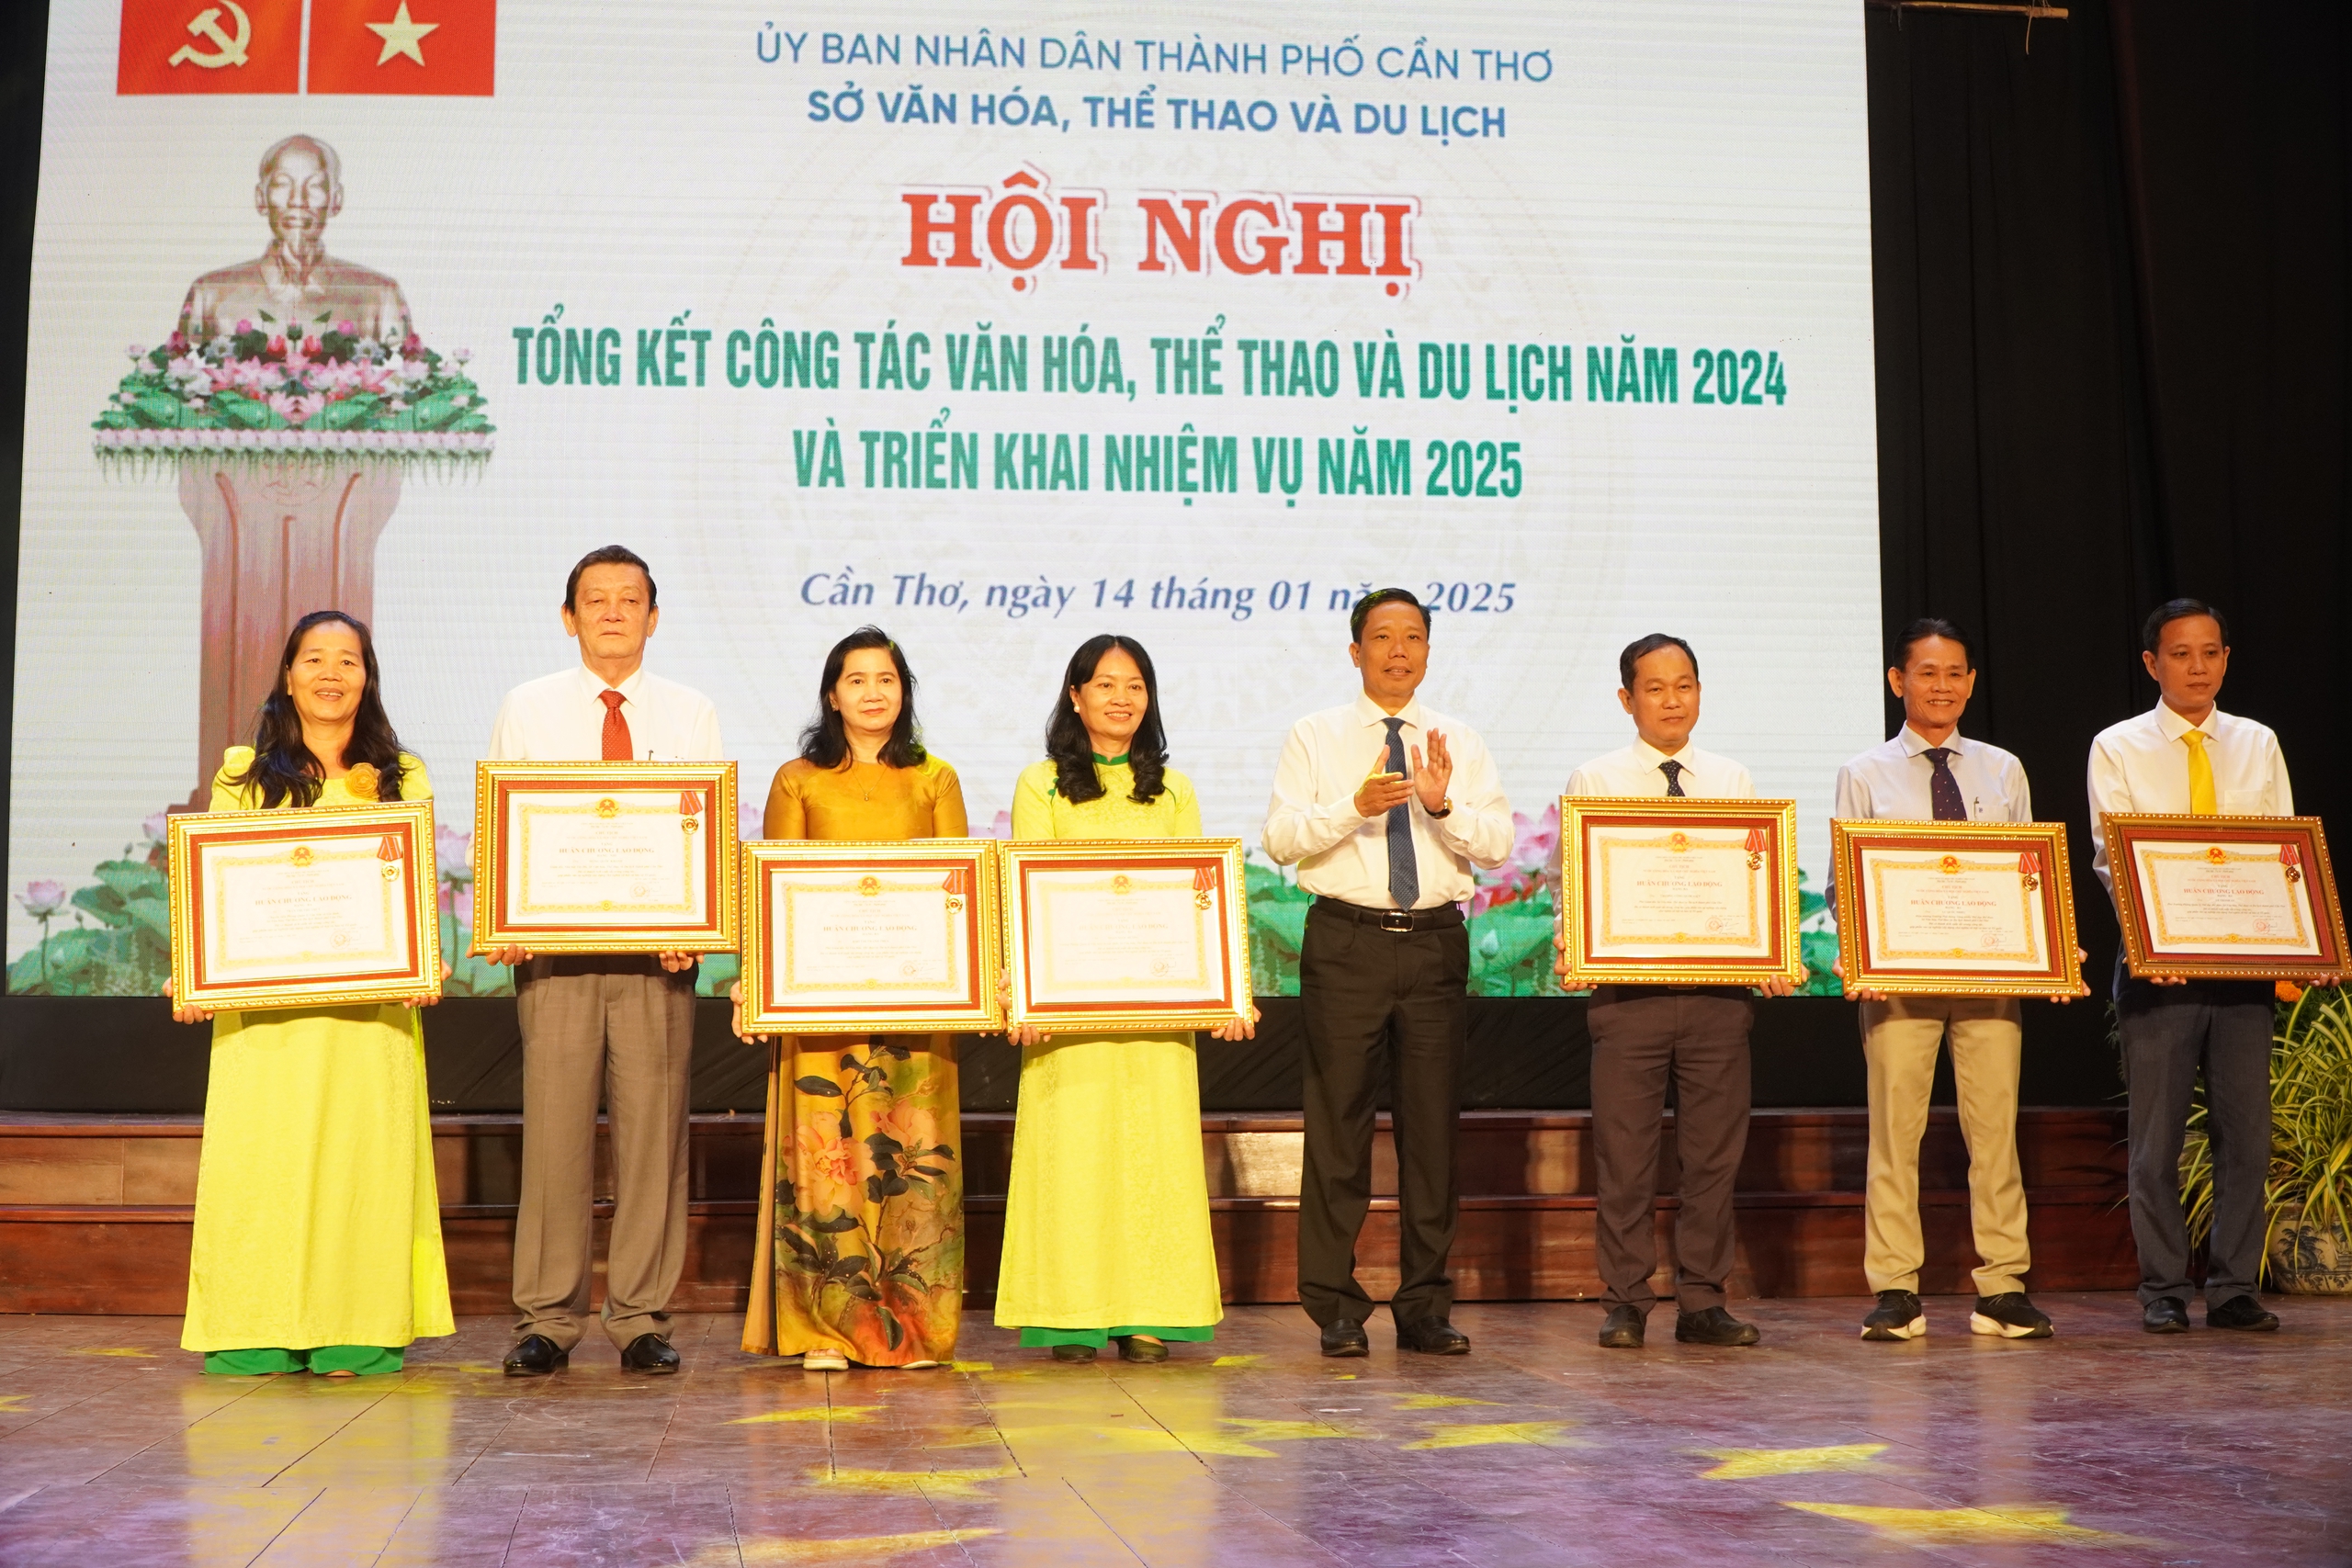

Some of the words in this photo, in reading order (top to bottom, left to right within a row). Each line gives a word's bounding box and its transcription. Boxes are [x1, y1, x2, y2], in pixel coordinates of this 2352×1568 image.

[756, 21, 808, 64] ỦY
[821, 32, 901, 65] BAN
[916, 28, 1026, 68] NHÂN
[1039, 30, 1122, 71] DÂN
[1134, 34, 1268, 74] THÀNH
[1281, 35, 1365, 77] PHỐ
[1376, 37, 1460, 80] CẦN
[1472, 49, 1555, 83] THƠ
[808, 81, 865, 123] SỞ
[877, 84, 957, 125] VĂN
[971, 86, 1071, 134] HÓA,
[1083, 84, 1157, 129] THỂ
[1167, 98, 1279, 133] THAO
[1290, 95, 1342, 134] VÀ
[1354, 103, 1408, 137] DU
[1420, 105, 1507, 147] LỊCH
[901, 173, 1100, 292] HỘI
[1138, 198, 1416, 298] NGHỊ
[513, 303, 622, 387] TỔNG
[638, 310, 713, 388] KẾT
[727, 318, 840, 390] CÔNG
[855, 321, 931, 391] TÁC
[946, 323, 1029, 393] VĂN
[1045, 325, 1136, 402] HÓA,
[1151, 317, 1227, 396] THỂ
[1238, 340, 1340, 399] THAO
[1354, 330, 1407, 400] VÀ
[1419, 343, 1472, 401] DU
[1487, 344, 1573, 414] LỊCH
[1588, 335, 1679, 404] NĂM
[1693, 348, 1788, 407] 2024
[793, 419, 846, 489] VÀ
[860, 408, 979, 491] TRIỂN
[995, 434, 1090, 491] KHAI
[1106, 423, 1238, 507] NHIỆM
[1253, 437, 1304, 509] VỤ
[1318, 426, 1412, 497] NĂM
[1427, 440, 1523, 500] 2025
[800, 566, 875, 605] Cần
[893, 572, 968, 614] Thơ,
[985, 575, 1076, 618] ngày
[1093, 579, 1135, 608] 14
[1150, 576, 1256, 621] tháng
[1269, 581, 1312, 611] 01
[1425, 581, 1516, 613] 2025
